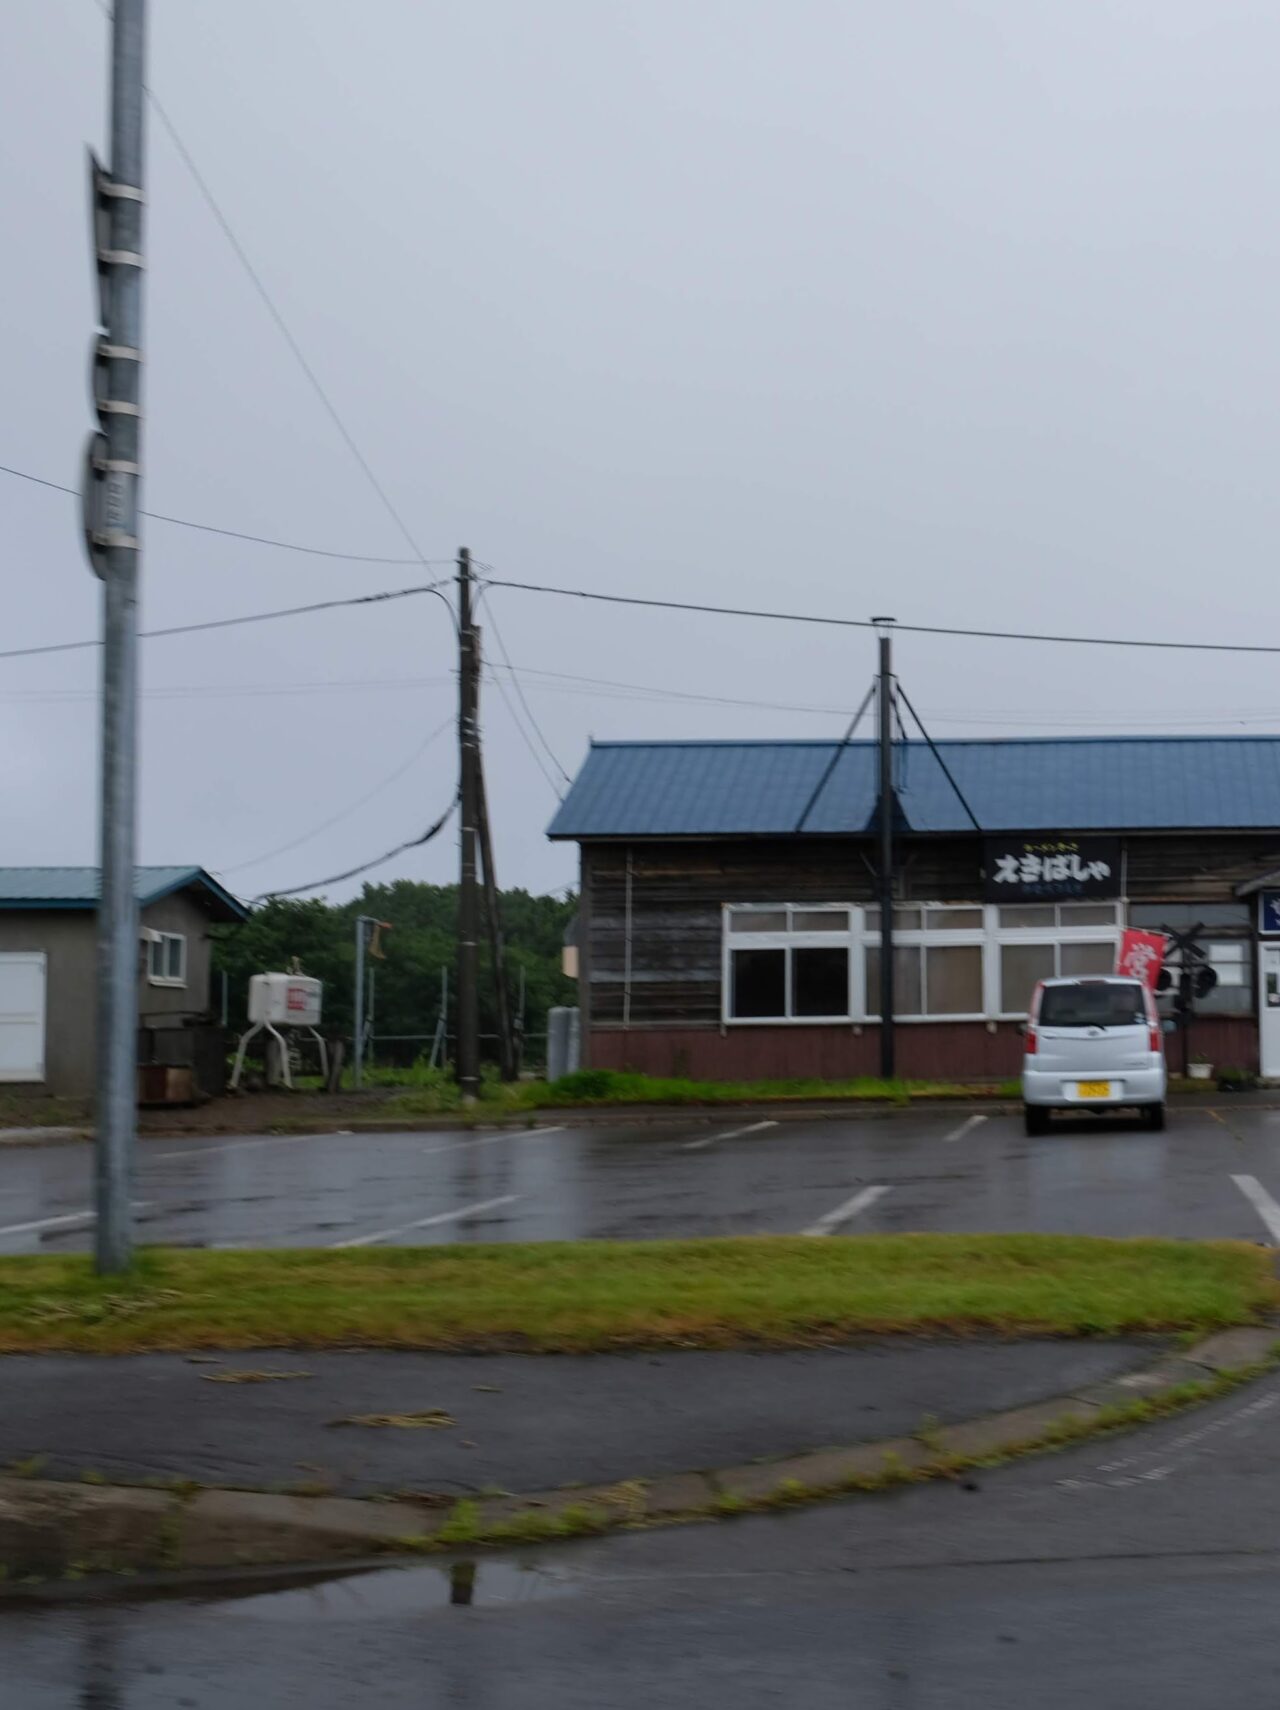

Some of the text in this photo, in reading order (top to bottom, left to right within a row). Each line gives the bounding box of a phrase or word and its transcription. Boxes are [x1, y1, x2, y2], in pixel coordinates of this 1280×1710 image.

[992, 853, 1112, 883] えきばしゃ
